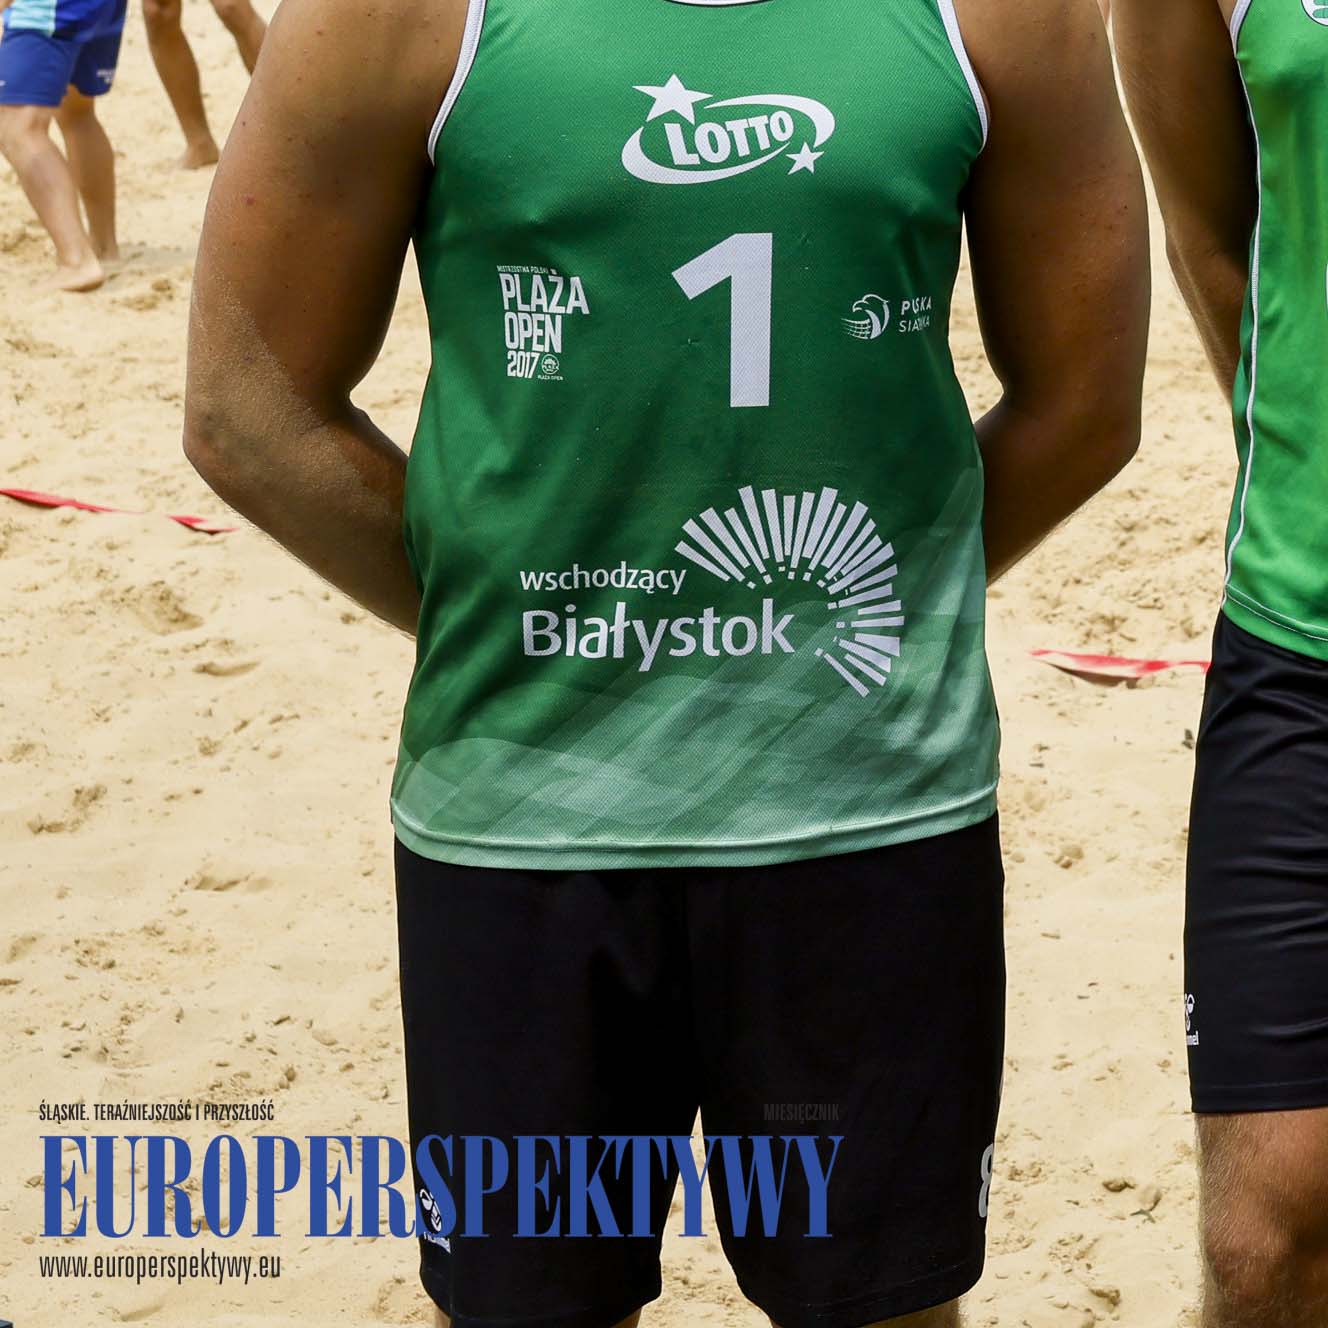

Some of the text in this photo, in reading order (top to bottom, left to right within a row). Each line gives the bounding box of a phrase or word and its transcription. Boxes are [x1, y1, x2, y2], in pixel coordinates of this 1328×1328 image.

[663, 109, 795, 167] LOTTO
[504, 311, 563, 353] OPEN
[671, 232, 774, 408] 1
[507, 350, 540, 379] 2017
[519, 561, 687, 596] wschodzący
[521, 598, 796, 671] Białystok
